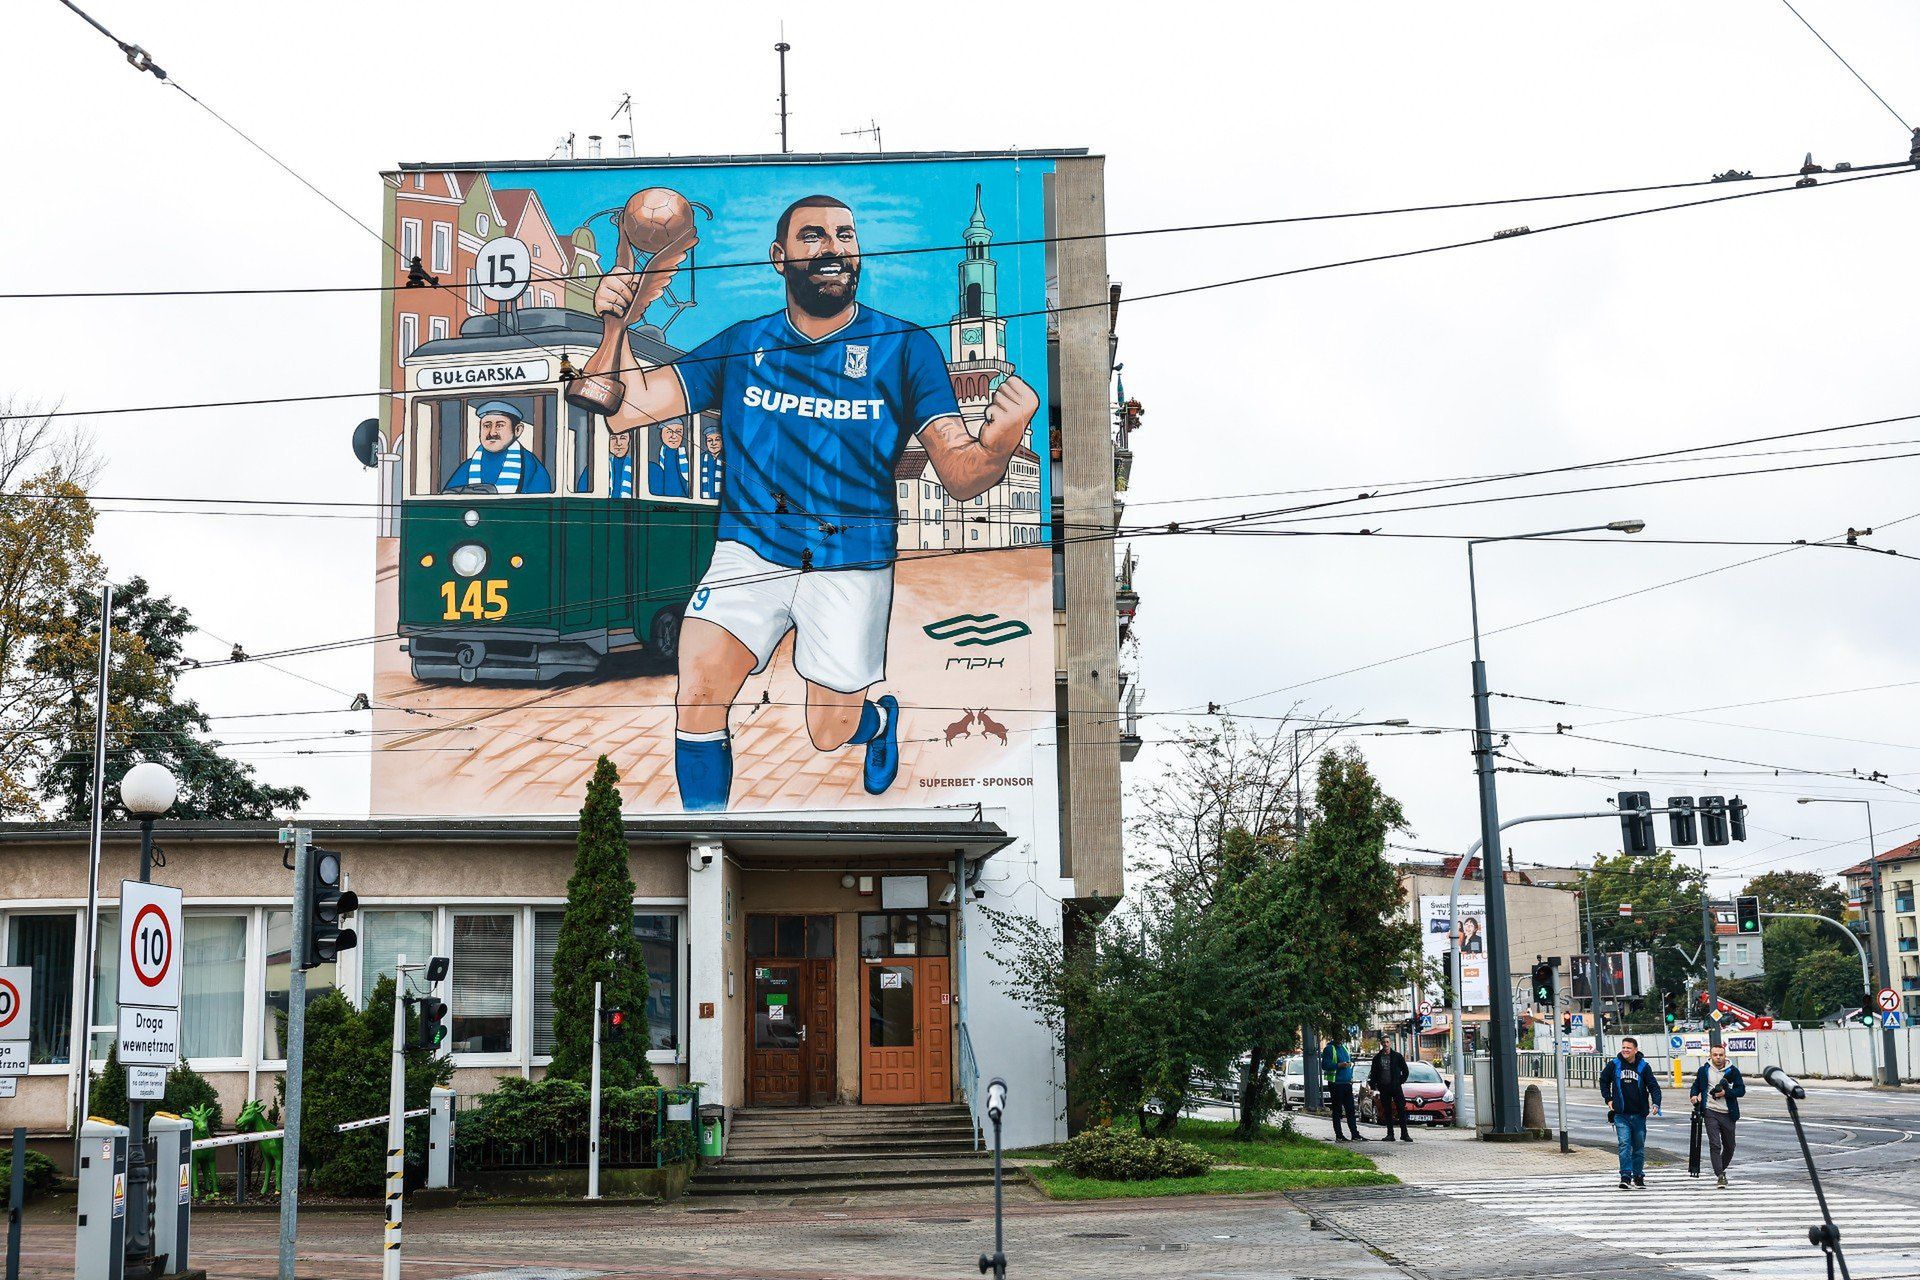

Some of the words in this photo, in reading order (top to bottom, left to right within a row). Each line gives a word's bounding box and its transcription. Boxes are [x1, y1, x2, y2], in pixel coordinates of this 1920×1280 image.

[487, 254, 516, 288] 15
[432, 365, 526, 385] BUŁGARSKA
[742, 385, 885, 420] SUPERBET
[440, 579, 509, 621] 145
[692, 586, 711, 611] 9
[945, 657, 1005, 670] MPK
[919, 777, 976, 788] SUPERBET
[982, 777, 1034, 787] SPONSOR
[140, 926, 164, 966] 10
[0, 991, 11, 1015] 0
[136, 1012, 163, 1034] Droga
[122, 1038, 174, 1056] wewnętrzna
